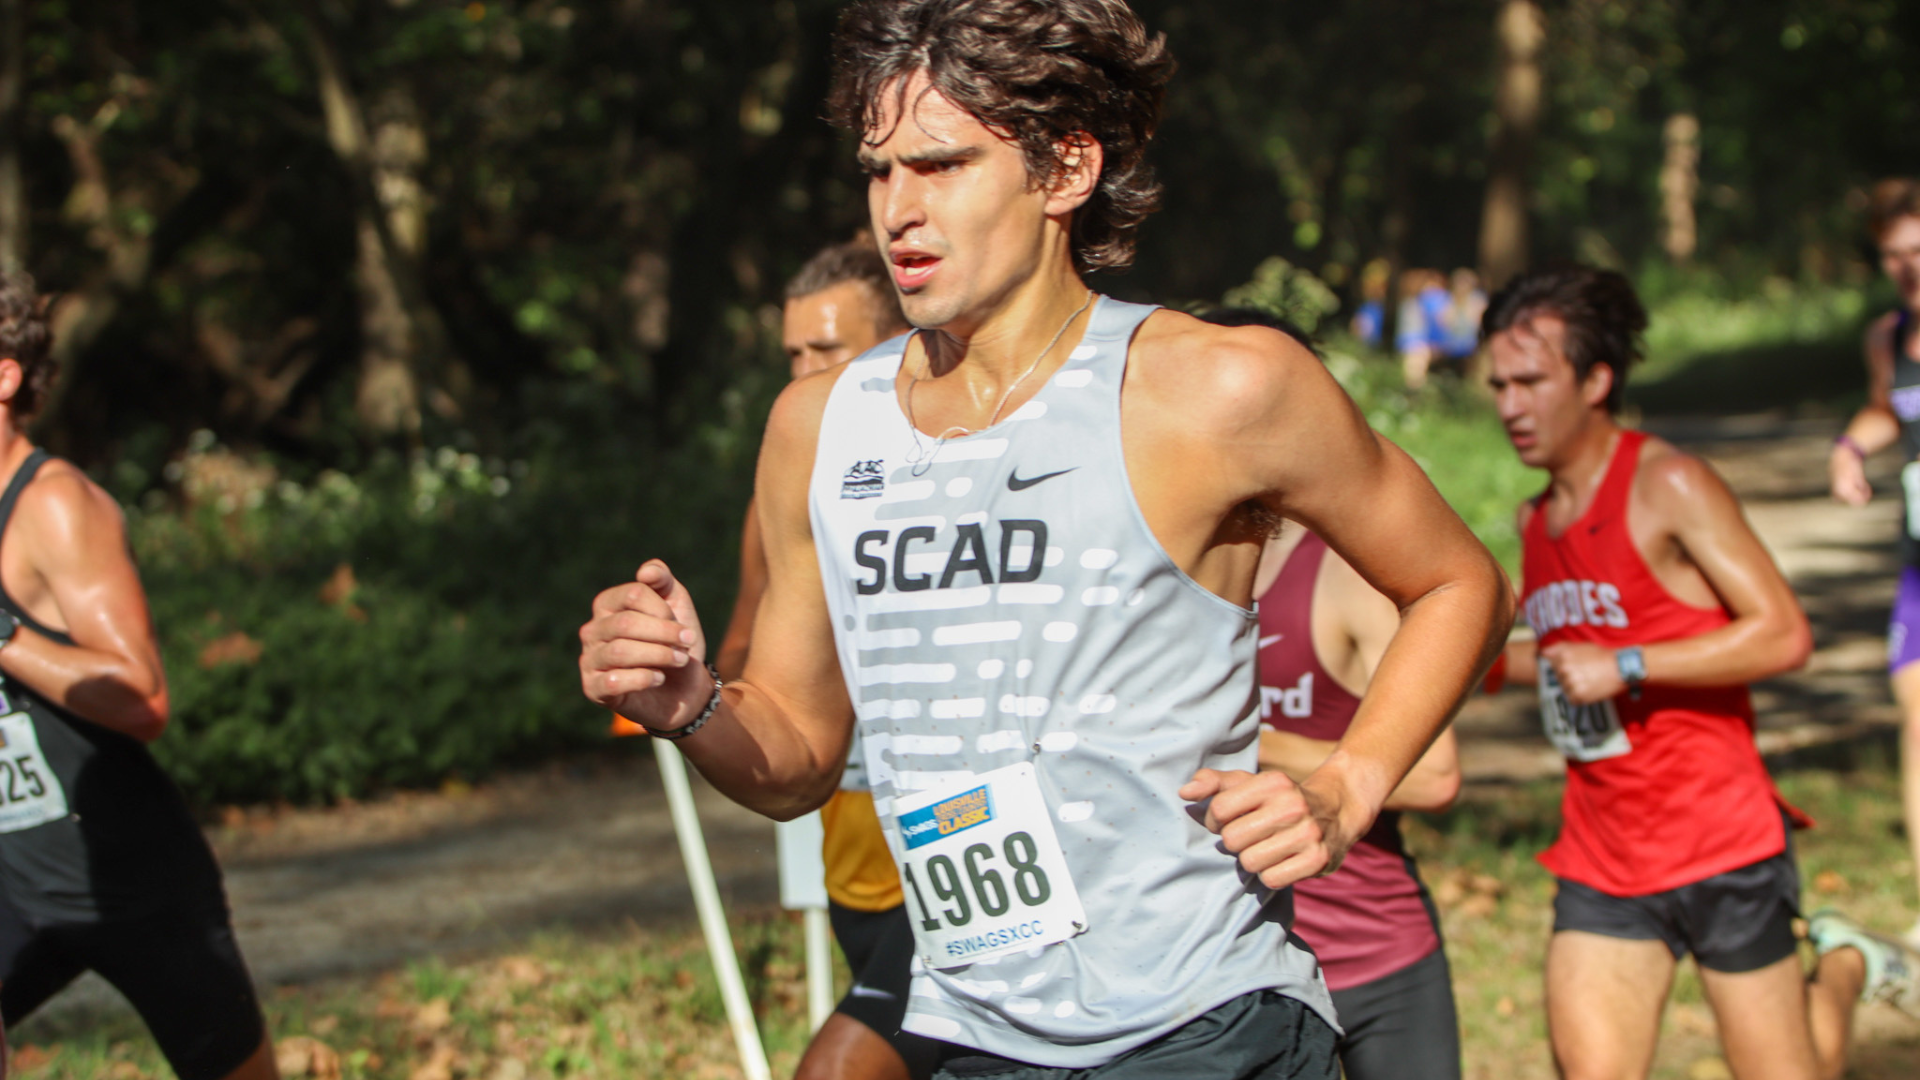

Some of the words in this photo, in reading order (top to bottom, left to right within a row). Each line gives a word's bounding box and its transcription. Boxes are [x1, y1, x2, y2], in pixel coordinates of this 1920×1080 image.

[854, 519, 1048, 596] SCAD
[0, 754, 46, 806] 25
[933, 788, 987, 817] LOUISVILLE
[938, 806, 990, 835] CLASSIC
[903, 831, 1051, 932] 1968
[945, 920, 1044, 957] #SWAGSXCC
